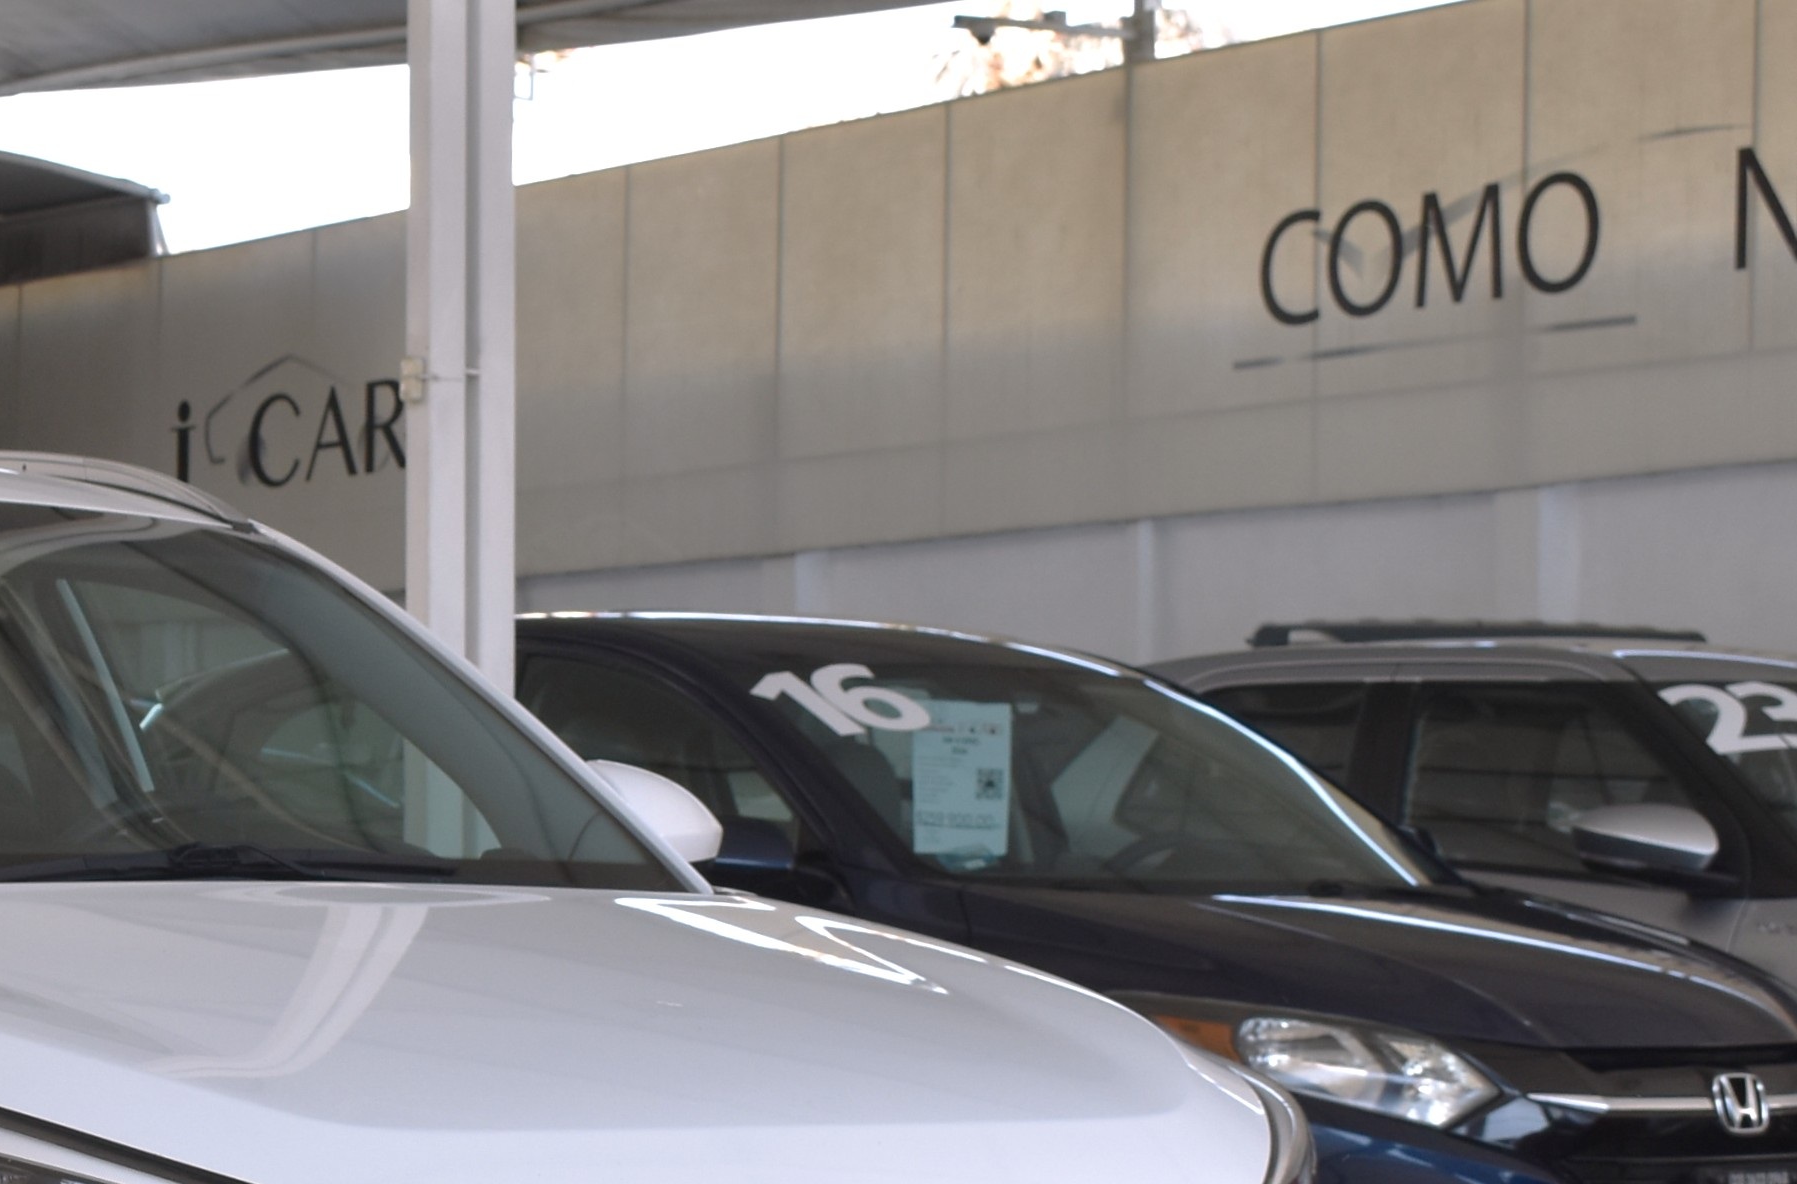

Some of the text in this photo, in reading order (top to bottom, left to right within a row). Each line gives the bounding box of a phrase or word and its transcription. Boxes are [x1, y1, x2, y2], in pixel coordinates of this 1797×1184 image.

[1260, 170, 1600, 326] COMO
[248, 379, 407, 488] CAR
[749, 663, 931, 736] 16
